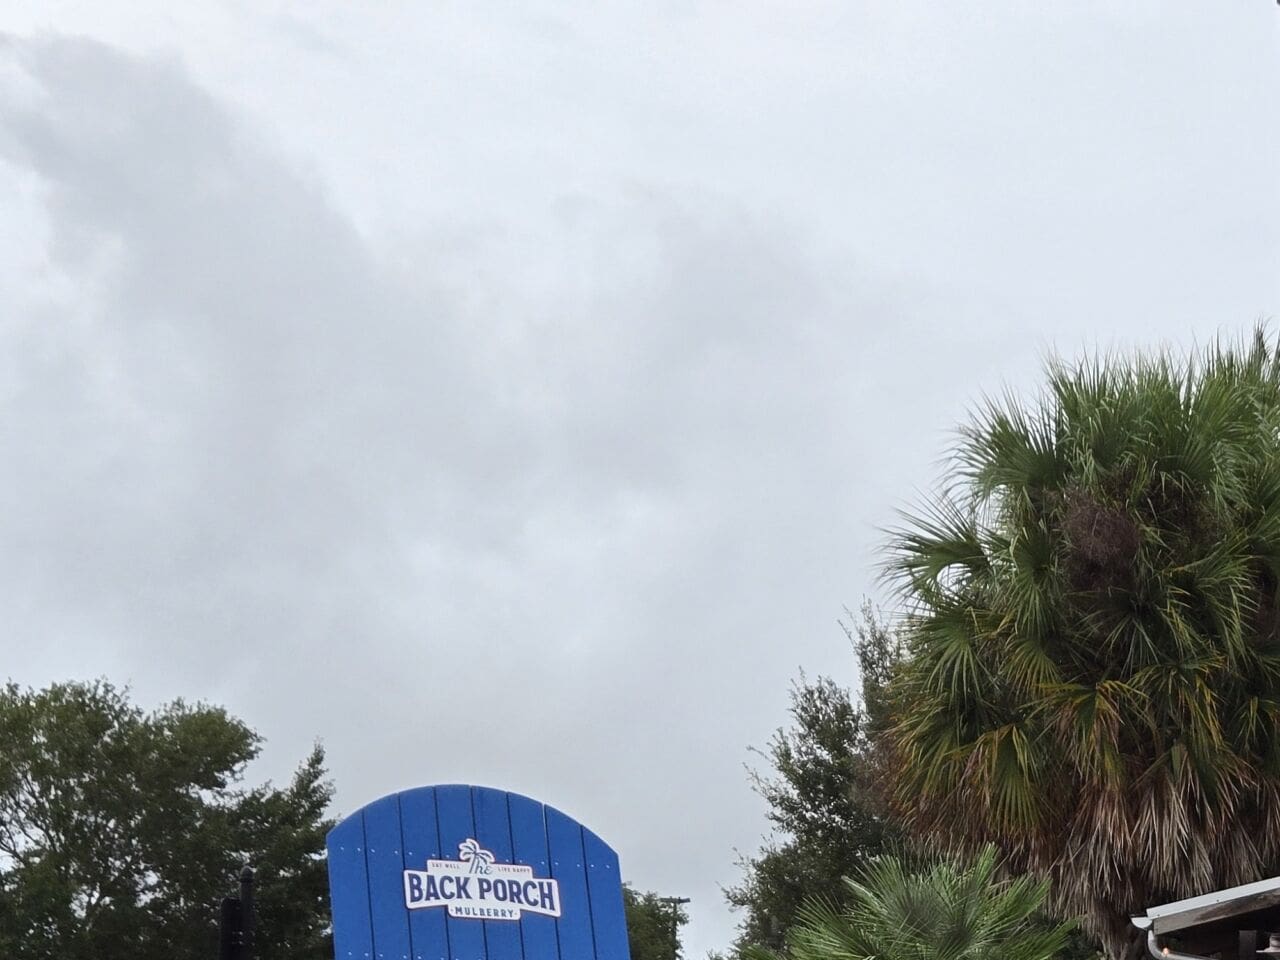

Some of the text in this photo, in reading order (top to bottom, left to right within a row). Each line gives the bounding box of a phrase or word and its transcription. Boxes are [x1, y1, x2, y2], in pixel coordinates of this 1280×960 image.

[407, 873, 556, 911] BACK PORCH
[455, 906, 514, 918] MULBERRY
